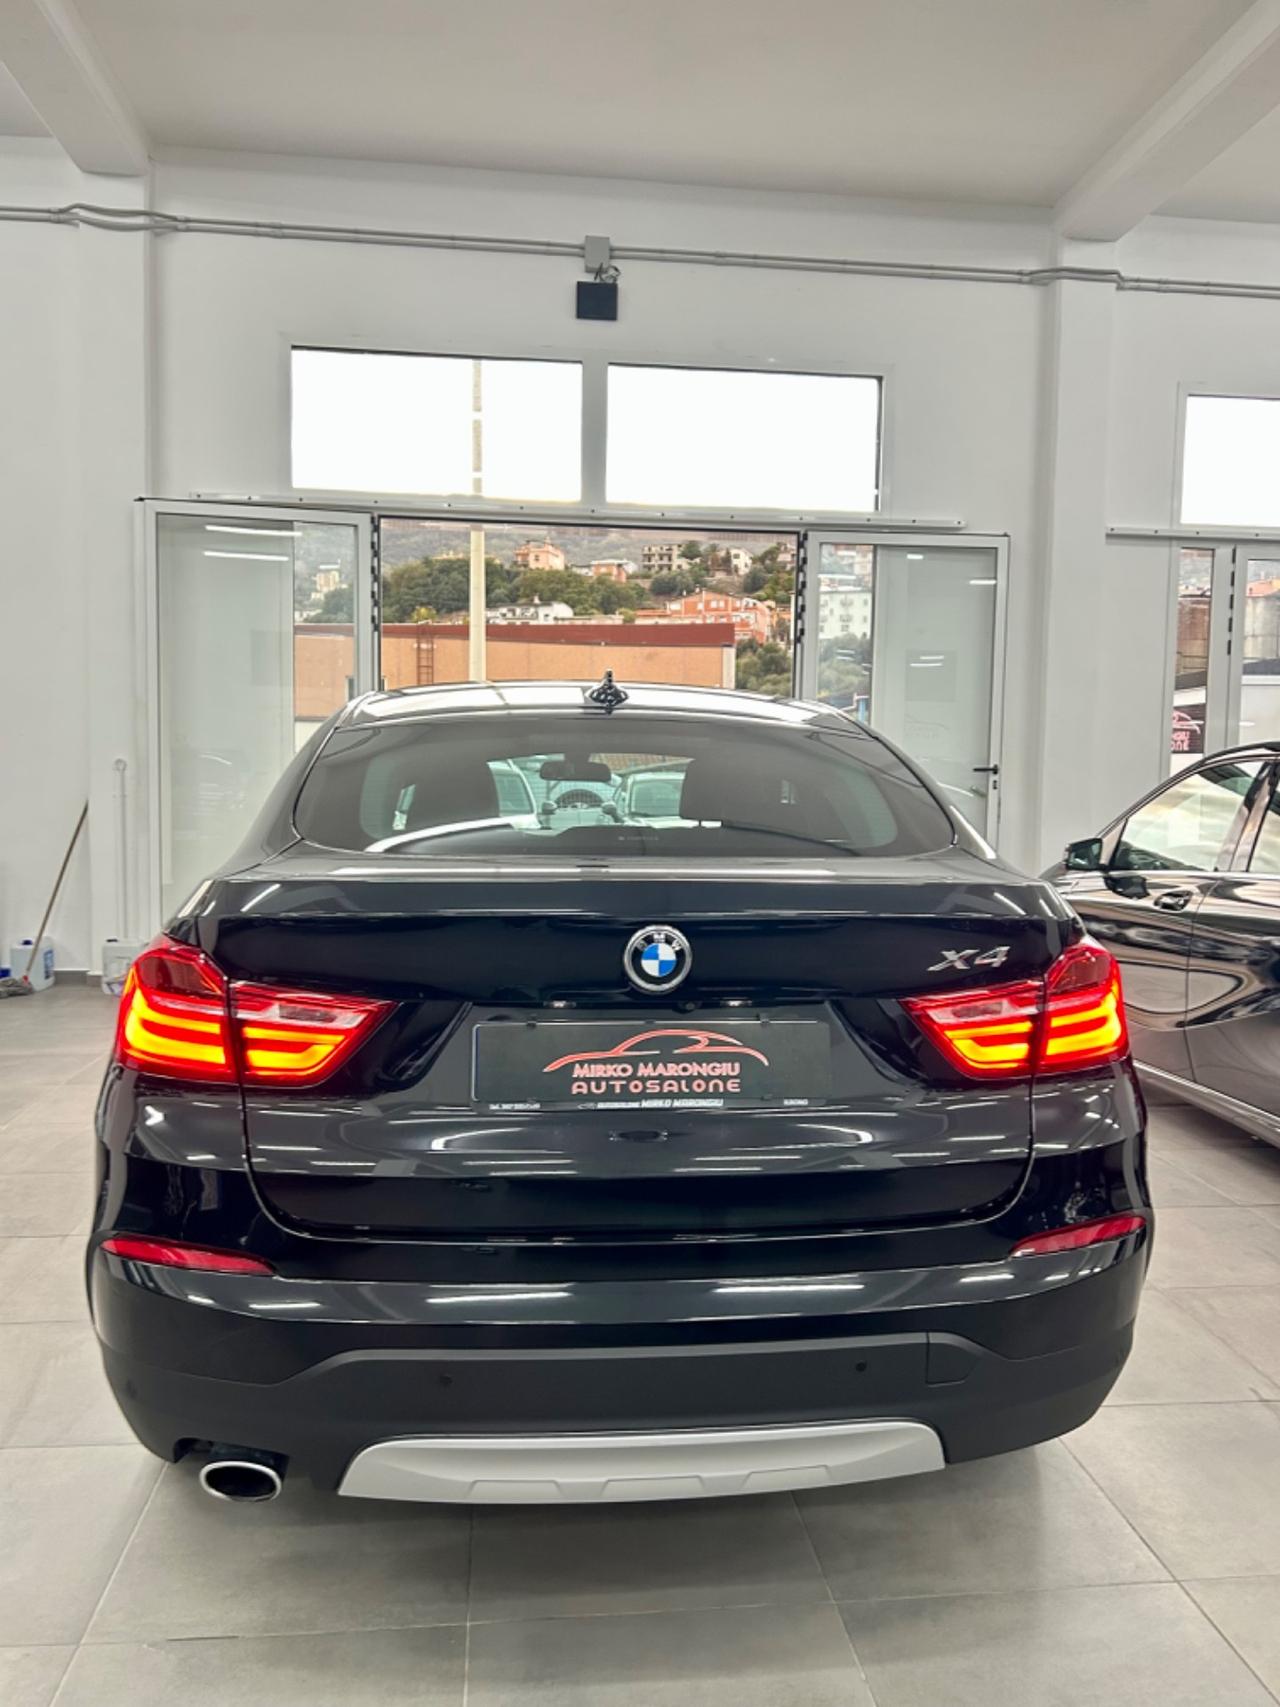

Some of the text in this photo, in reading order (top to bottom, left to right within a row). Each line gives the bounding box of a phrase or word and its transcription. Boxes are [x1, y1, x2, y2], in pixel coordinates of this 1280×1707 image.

[926, 946, 1011, 972] X4
[571, 1061, 741, 1078] MIRKO MARONGIU
[571, 1078, 741, 1095] AUTOSALONE
